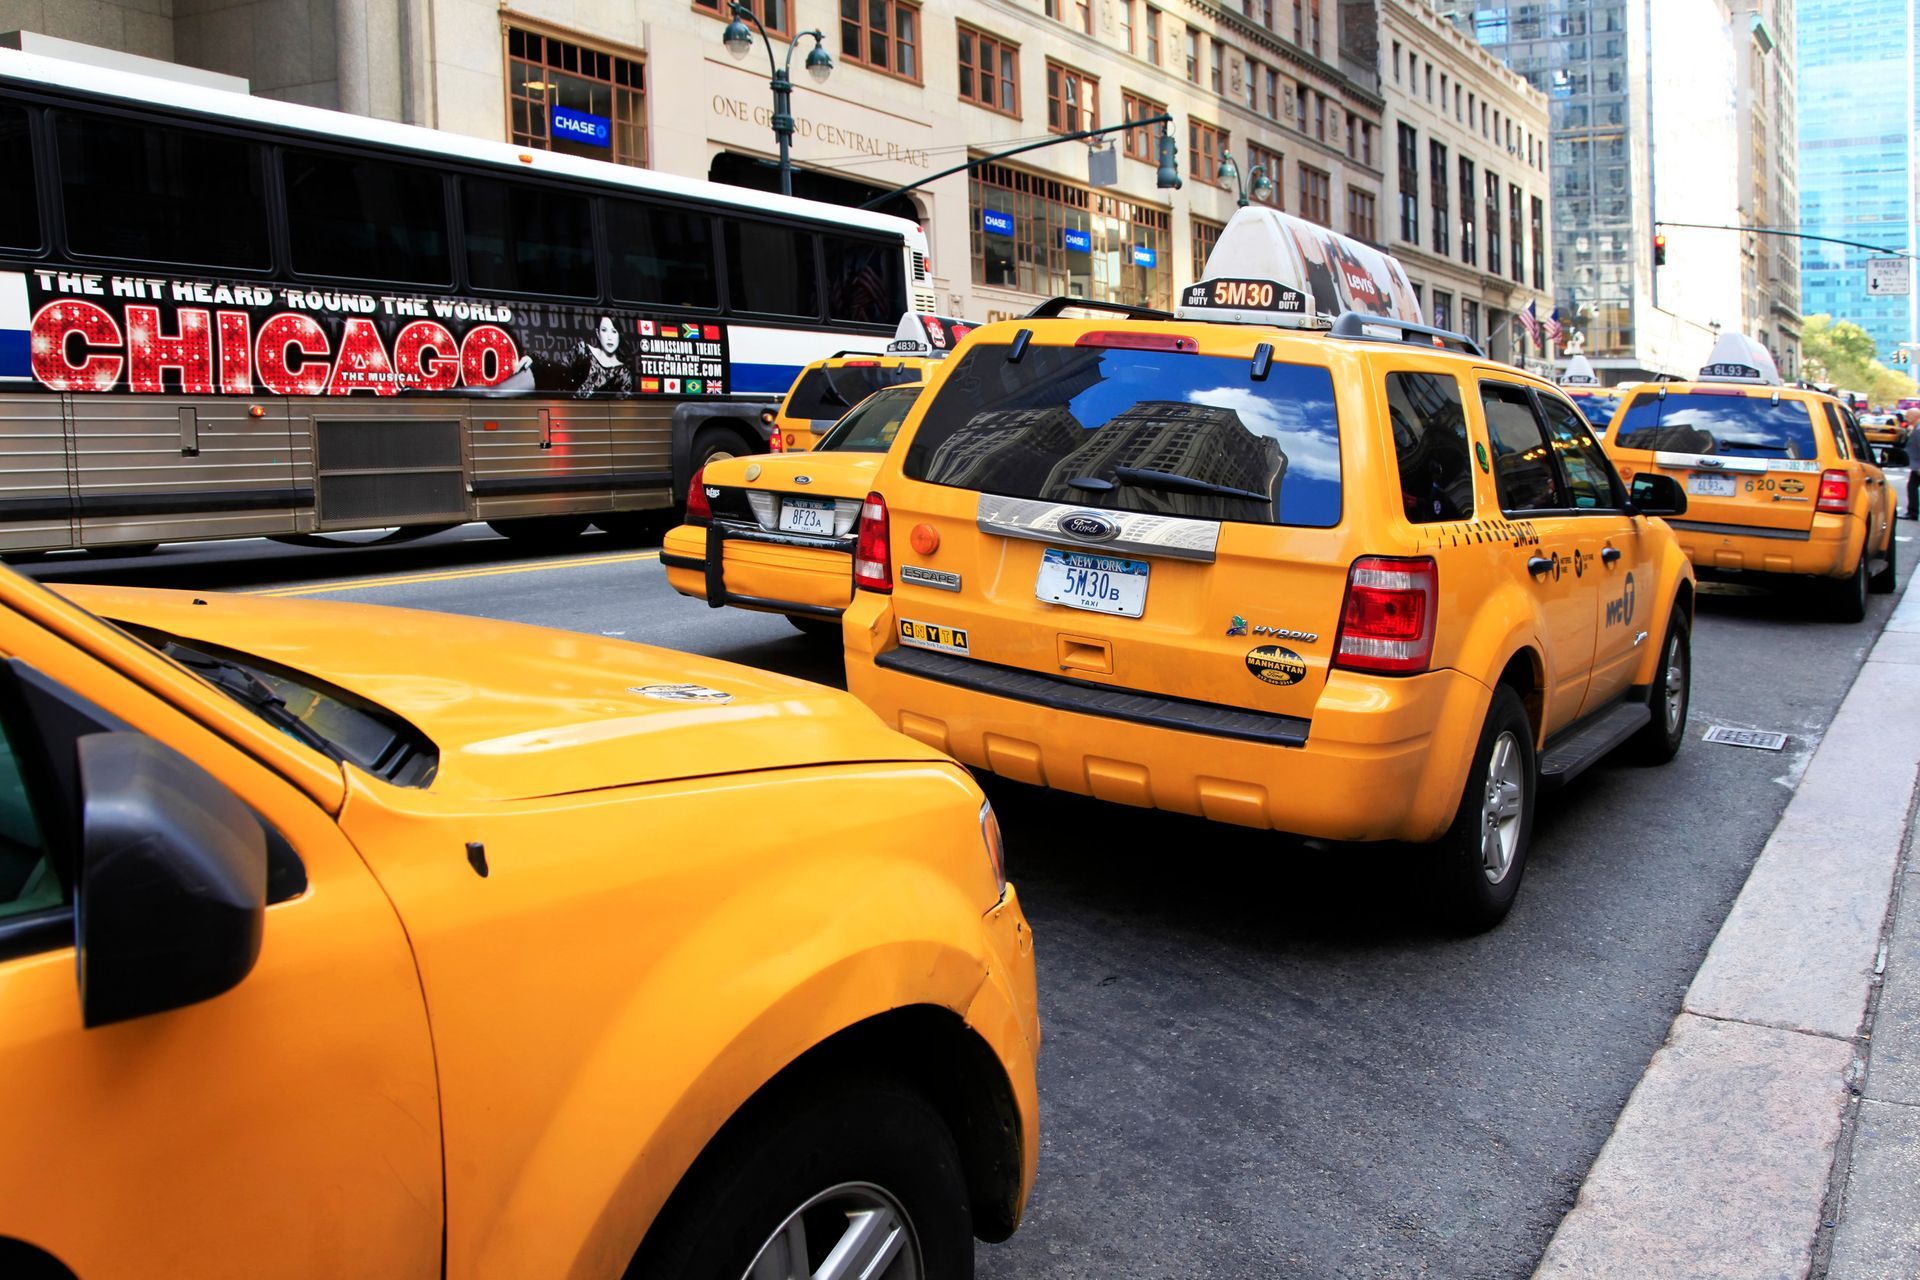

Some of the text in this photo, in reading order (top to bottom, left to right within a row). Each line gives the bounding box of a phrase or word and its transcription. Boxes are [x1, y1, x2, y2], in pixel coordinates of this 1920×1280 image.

[555, 116, 596, 136] CHASE
[712, 95, 929, 169] ONE GND CENTRAL PLACE
[985, 216, 1007, 229] CHASE
[1065, 234, 1085, 246] CHASE
[34, 269, 104, 295] THE
[111, 276, 166, 300] HIT
[172, 281, 272, 306] HEARD
[381, 297, 428, 317] THE
[432, 301, 512, 323] WORLD
[1192, 288, 1206, 297] OFF
[1214, 281, 1273, 307] 5M30
[1283, 291, 1297, 301] OFF
[1188, 296, 1208, 306] DUTY
[1278, 300, 1300, 310] DUTY
[30, 299, 519, 396] CHICAGO
[650, 340, 722, 356] AMBASSADOR THEATRE
[897, 341, 916, 351] 4B30
[641, 360, 722, 377] TELECHARGE.COM
[1714, 365, 1742, 376] 6L93
[341, 372, 421, 382] THE MUSICAL
[1071, 518, 1098, 534] Ford
[1507, 521, 1539, 547] 5M30
[1070, 555, 1123, 573] NEW YORK
[904, 568, 957, 585] ESCAPE
[1081, 599, 1098, 607] TAXI
[1252, 625, 1319, 644] HYBRID
[1247, 657, 1304, 675] MANHATTAN
[1266, 670, 1284, 680] Ford
